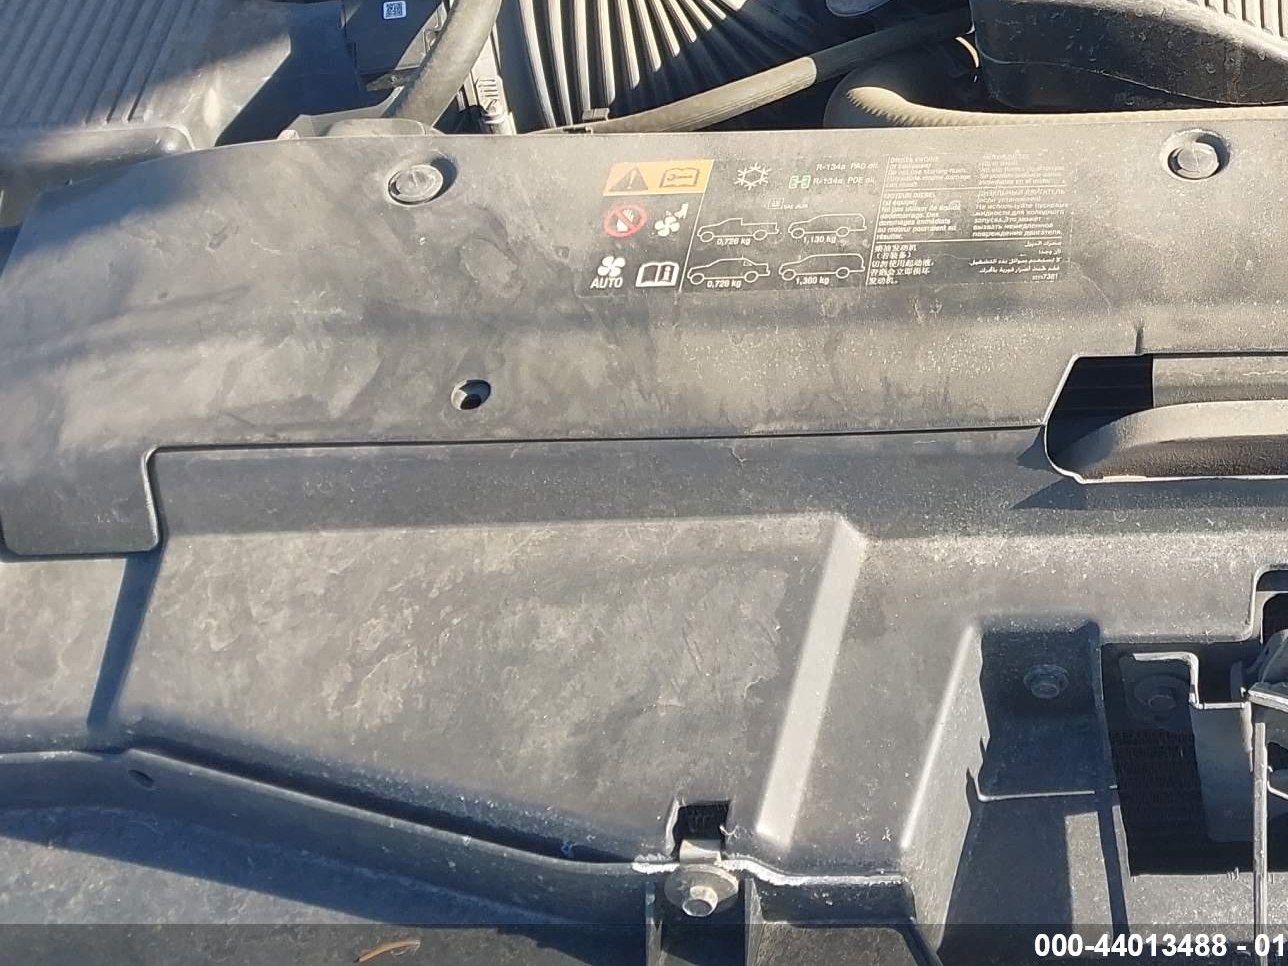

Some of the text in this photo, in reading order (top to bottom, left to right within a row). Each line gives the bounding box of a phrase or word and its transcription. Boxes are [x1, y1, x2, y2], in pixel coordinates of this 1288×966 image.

[816, 162, 846, 171] R-134a
[813, 177, 843, 185] R-134a
[847, 176, 864, 184] POE
[741, 237, 751, 246] kg
[826, 235, 837, 244] kg
[590, 277, 624, 289] AUTO
[731, 279, 742, 288] kg
[818, 276, 830, 285] kg
